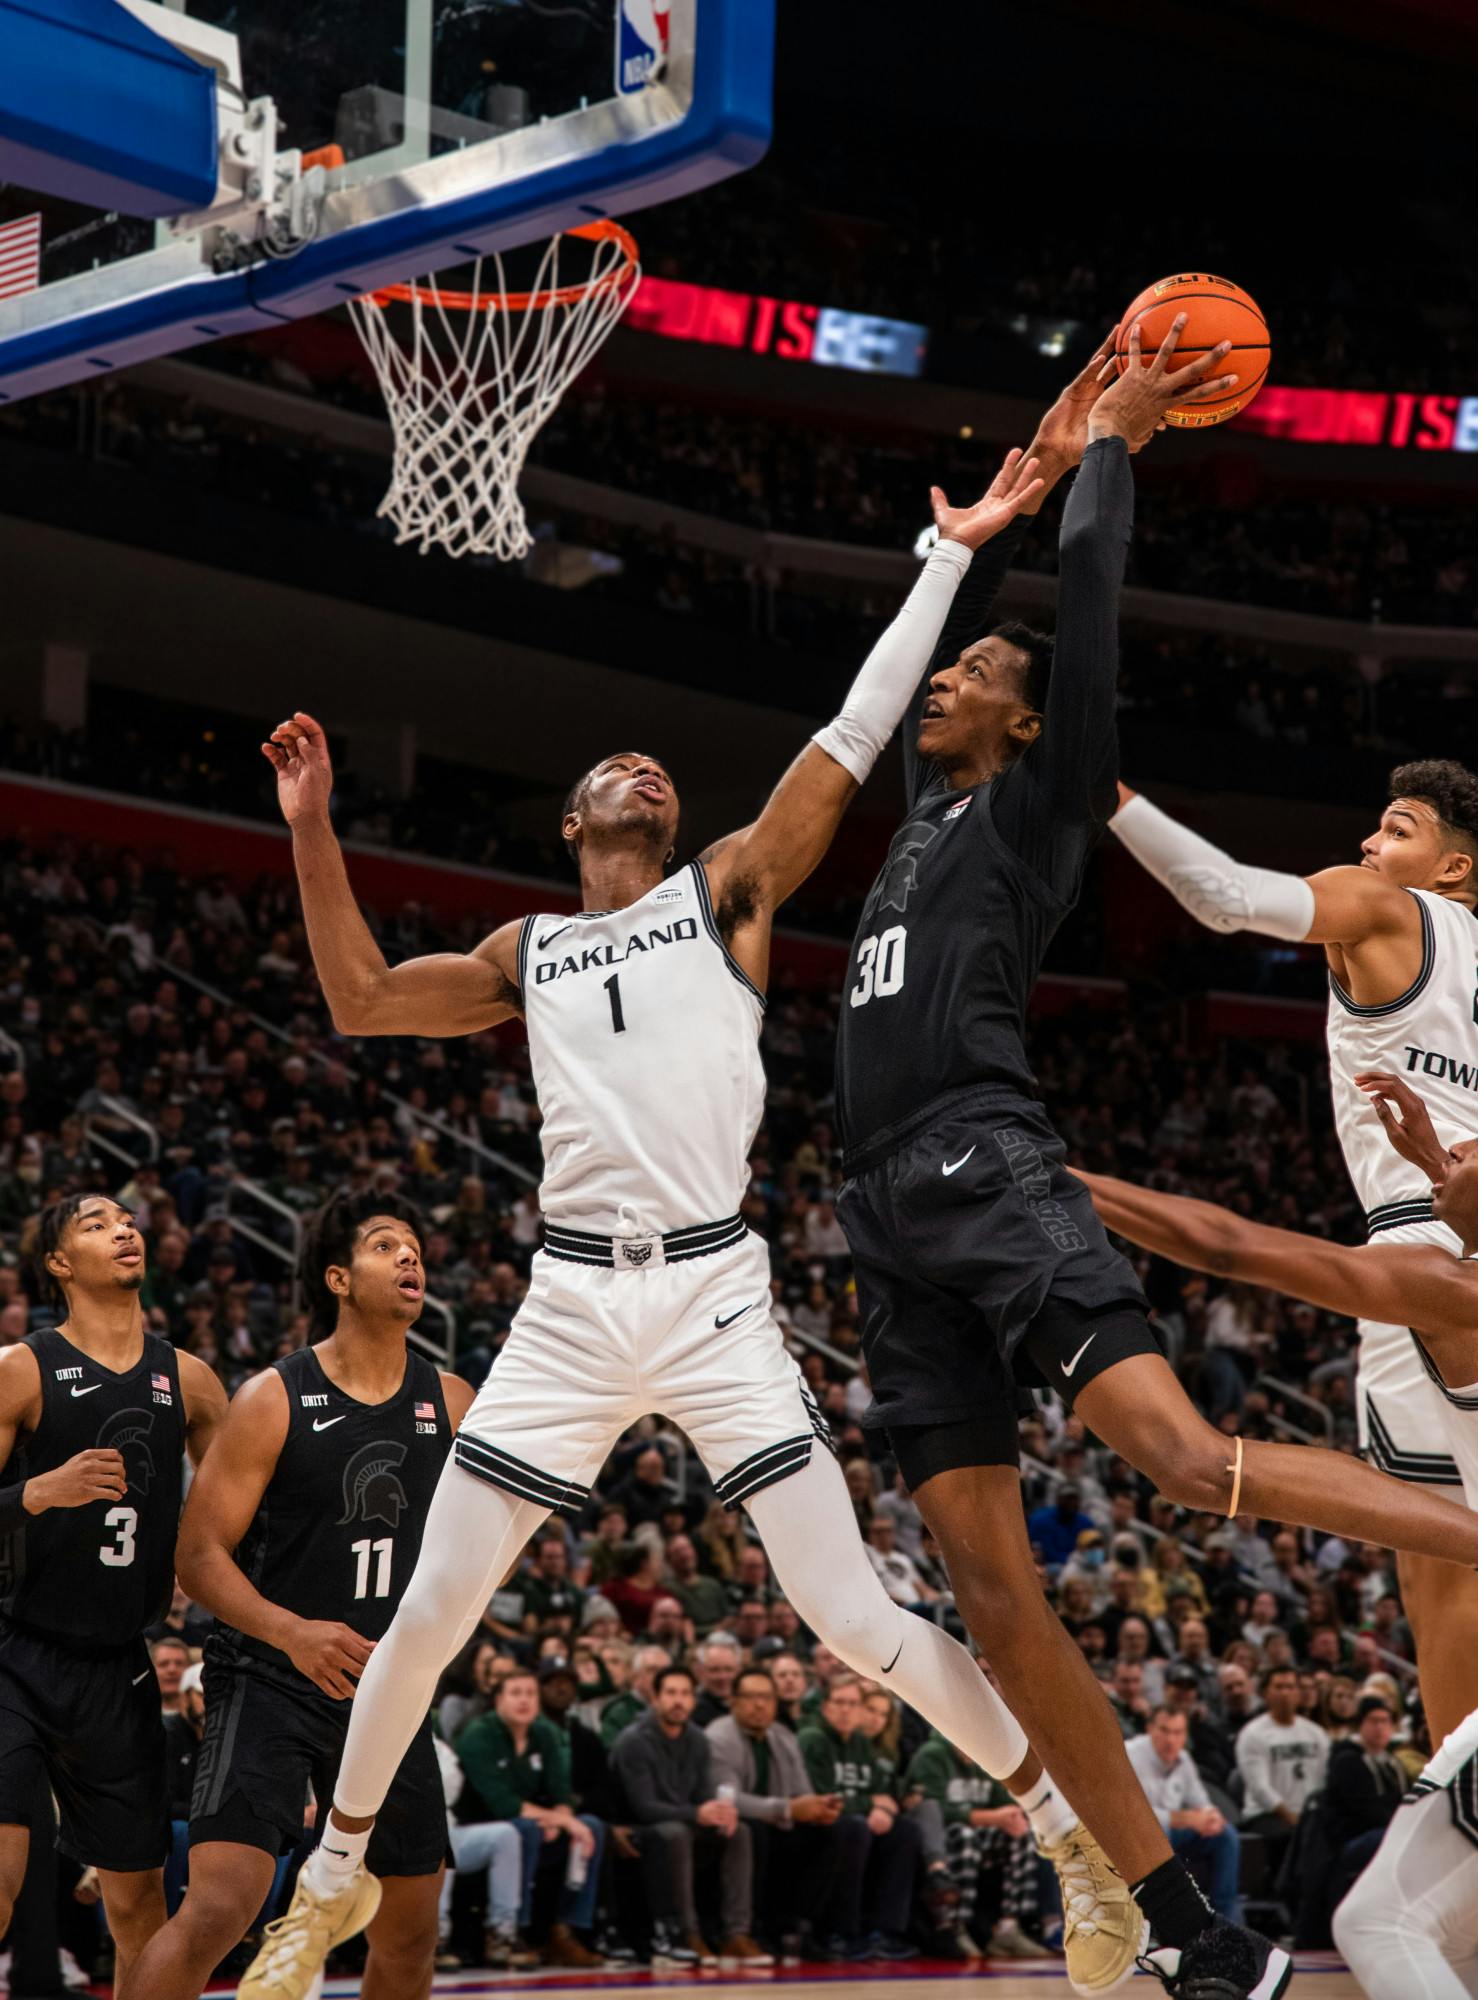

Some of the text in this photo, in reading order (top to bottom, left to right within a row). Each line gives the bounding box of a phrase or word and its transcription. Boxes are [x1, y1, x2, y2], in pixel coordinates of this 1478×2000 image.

[623, 52, 652, 87] NBA
[536, 917, 698, 985] OAKLAND
[850, 924, 907, 1009] 30
[603, 973, 626, 1034] 1
[1405, 1046, 1478, 1092] TOW
[993, 1128, 1088, 1252] SPARTANS
[55, 1366, 83, 1381] UNITY
[301, 1394, 329, 1407] UNITY
[99, 1507, 138, 1567] 3
[351, 1538, 394, 1600] 11
